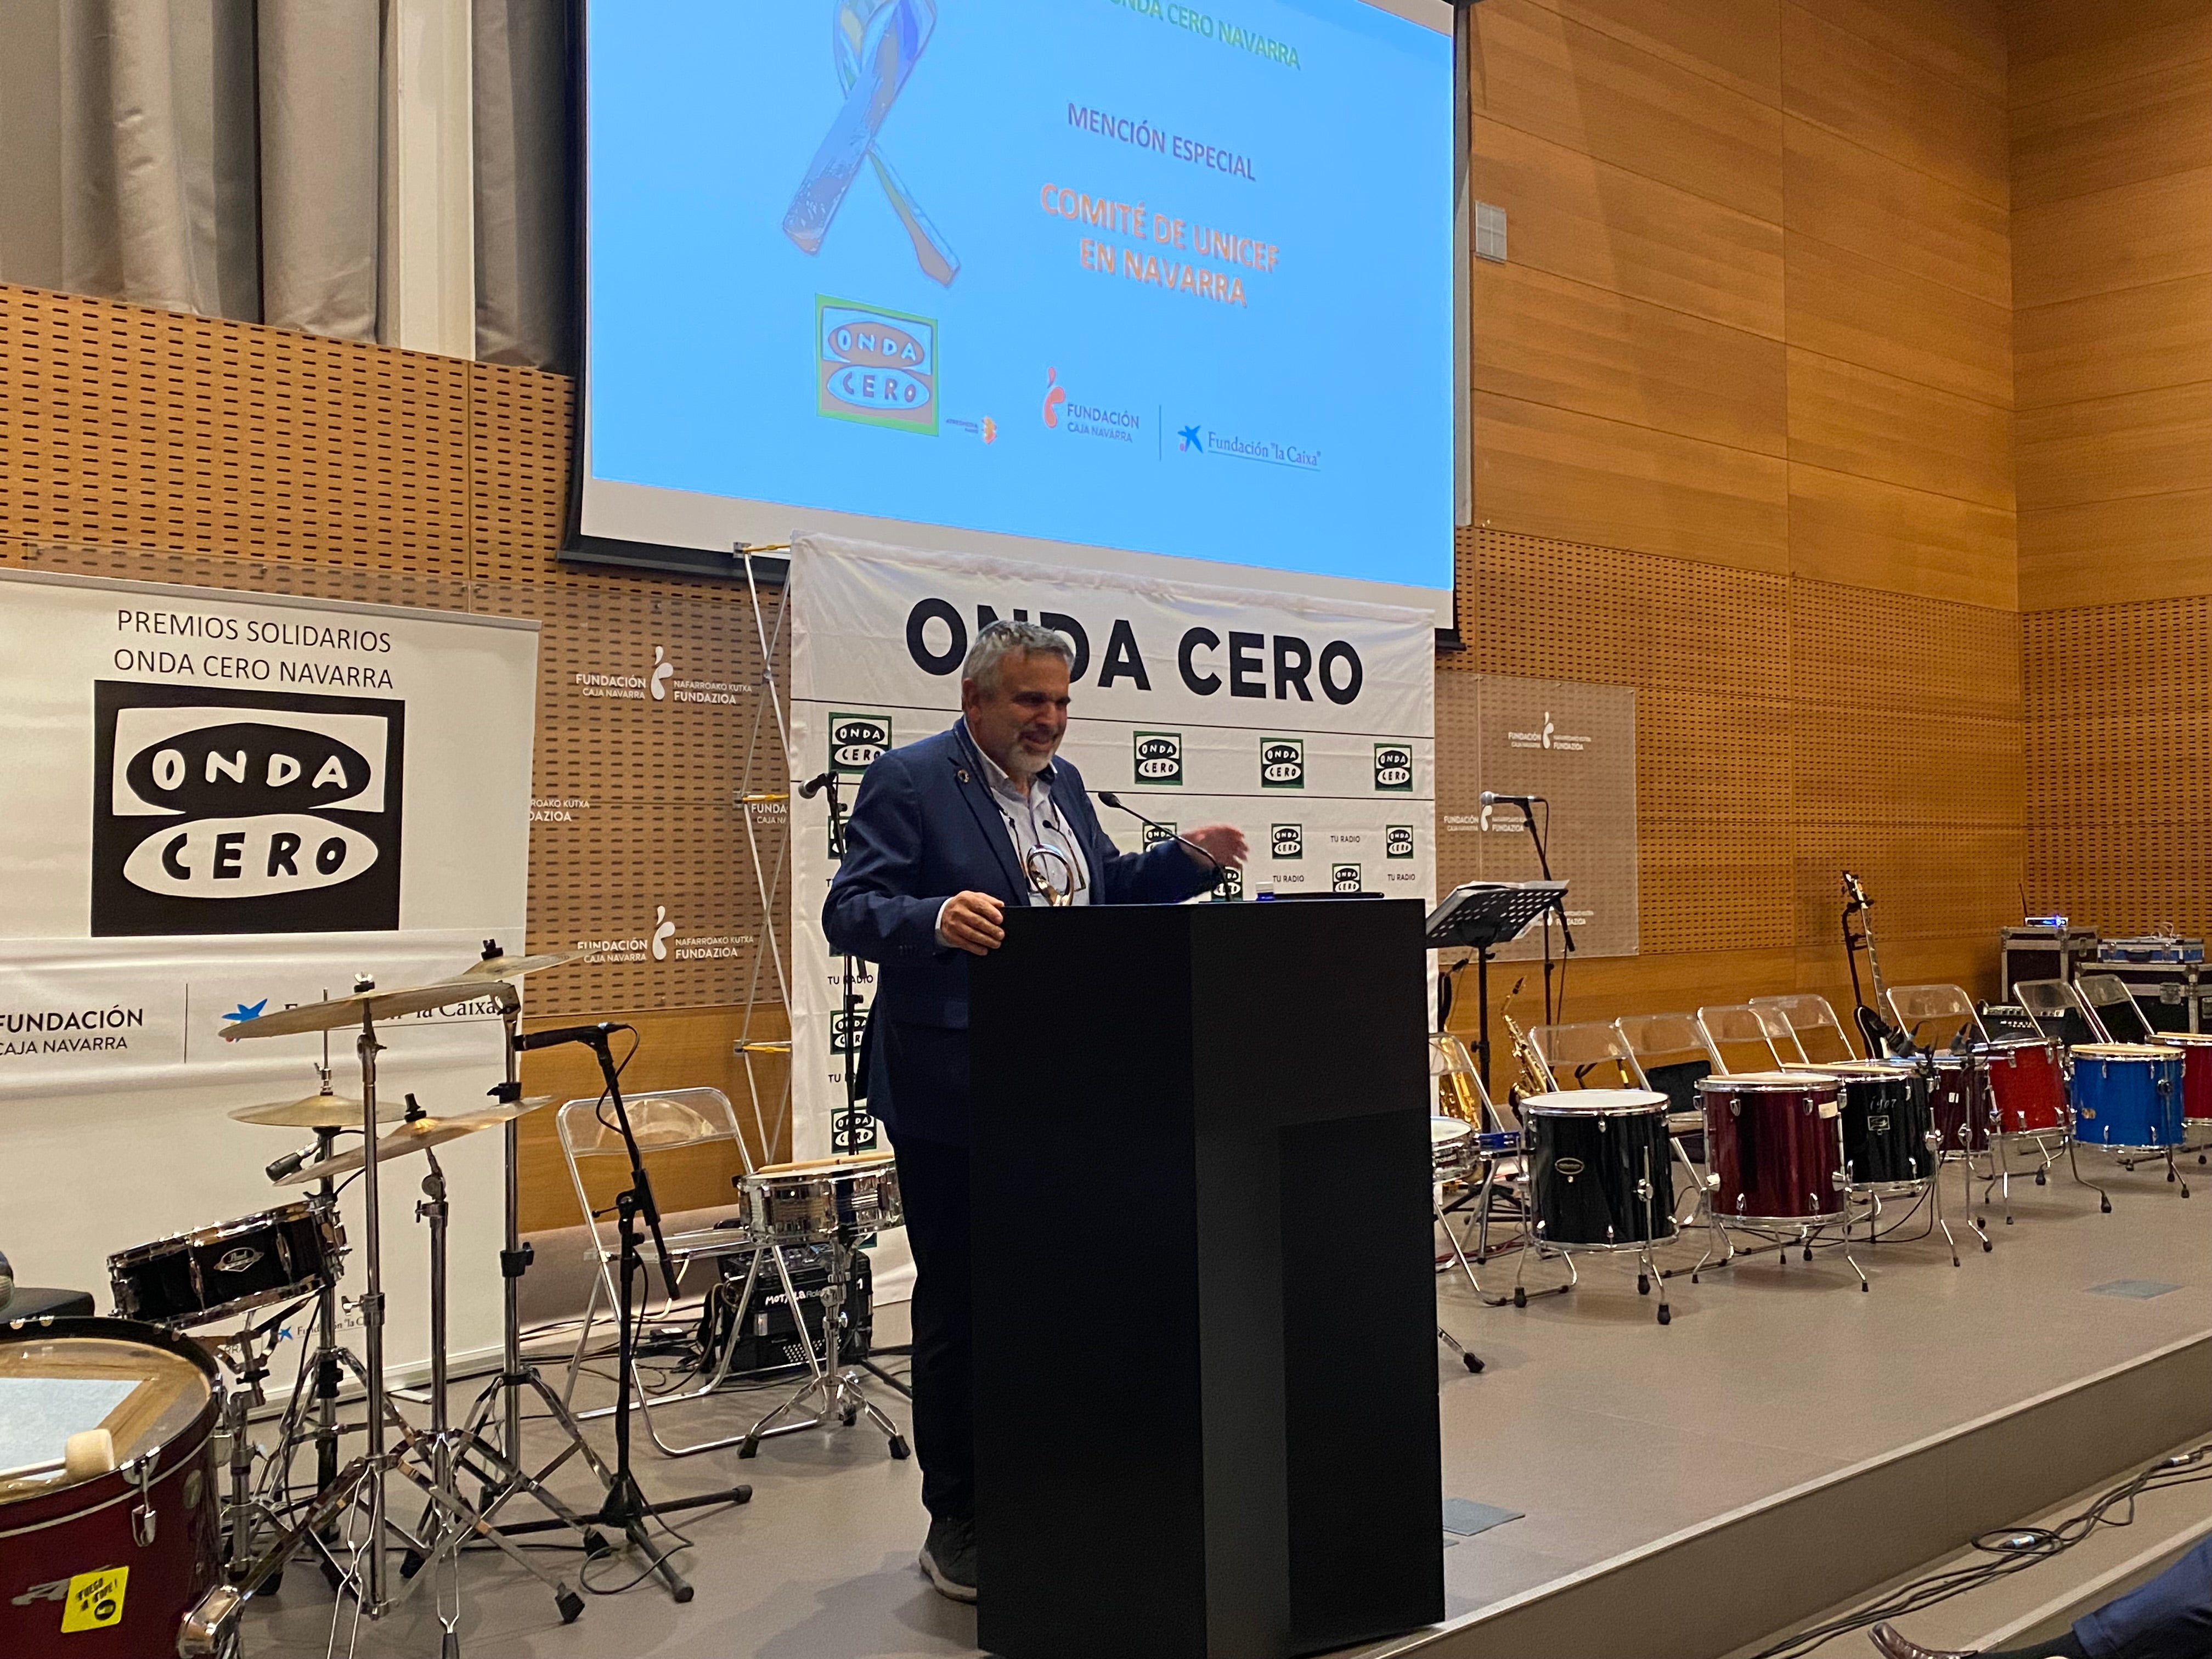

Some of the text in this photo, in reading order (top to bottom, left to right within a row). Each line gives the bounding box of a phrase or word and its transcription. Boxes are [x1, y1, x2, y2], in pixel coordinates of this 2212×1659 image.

[1109, 0, 1301, 71] NDA CERO NAVARRA
[1068, 103, 1256, 182] MENCIÓN ESPECIAL
[1041, 183, 1280, 273] COMITÉ DE UNICEF
[1080, 238, 1247, 308] EN NAVARRA
[837, 329, 916, 362] ONDA
[843, 371, 917, 403] CERO
[1067, 404, 1140, 429] FUNDACIÓN
[1067, 422, 1133, 443] CAJA NAVARRA
[1208, 431, 1268, 458] Fundación
[117, 609, 392, 653] PREMIOS SOLIDARIOS
[906, 597, 1363, 705] ODA CERO
[114, 648, 394, 690] ONDA CERO NAVARRA
[576, 674, 646, 689] FUNDACIÓN
[674, 680, 753, 693] NAFARROAKO KUTXA
[582, 687, 646, 699] CAJA NAVARRA
[674, 690, 737, 704] FUNDAZIOA
[839, 728, 881, 740] ONDA
[1142, 744, 1173, 754] ONDA
[1267, 750, 1296, 760] ONDA
[1380, 755, 1406, 764] ONDA
[151, 748, 348, 791] ONDA
[1144, 763, 1173, 773] CERO
[1269, 767, 1296, 777] CERO
[1383, 771, 1406, 781] CERO
[563, 800, 590, 808] KUTXA
[751, 803, 788, 814] FUNDA
[161, 831, 347, 881] CERO
[675, 935, 754, 946] NAFARROAKO KUTXA
[583, 953, 646, 964] CAJA NAVARRA
[675, 947, 738, 960] FUNDAZIOA
[827, 975, 839, 985] TU
[43, 1036, 128, 1053] NAVARRA
[828, 1074, 841, 1083] TU
